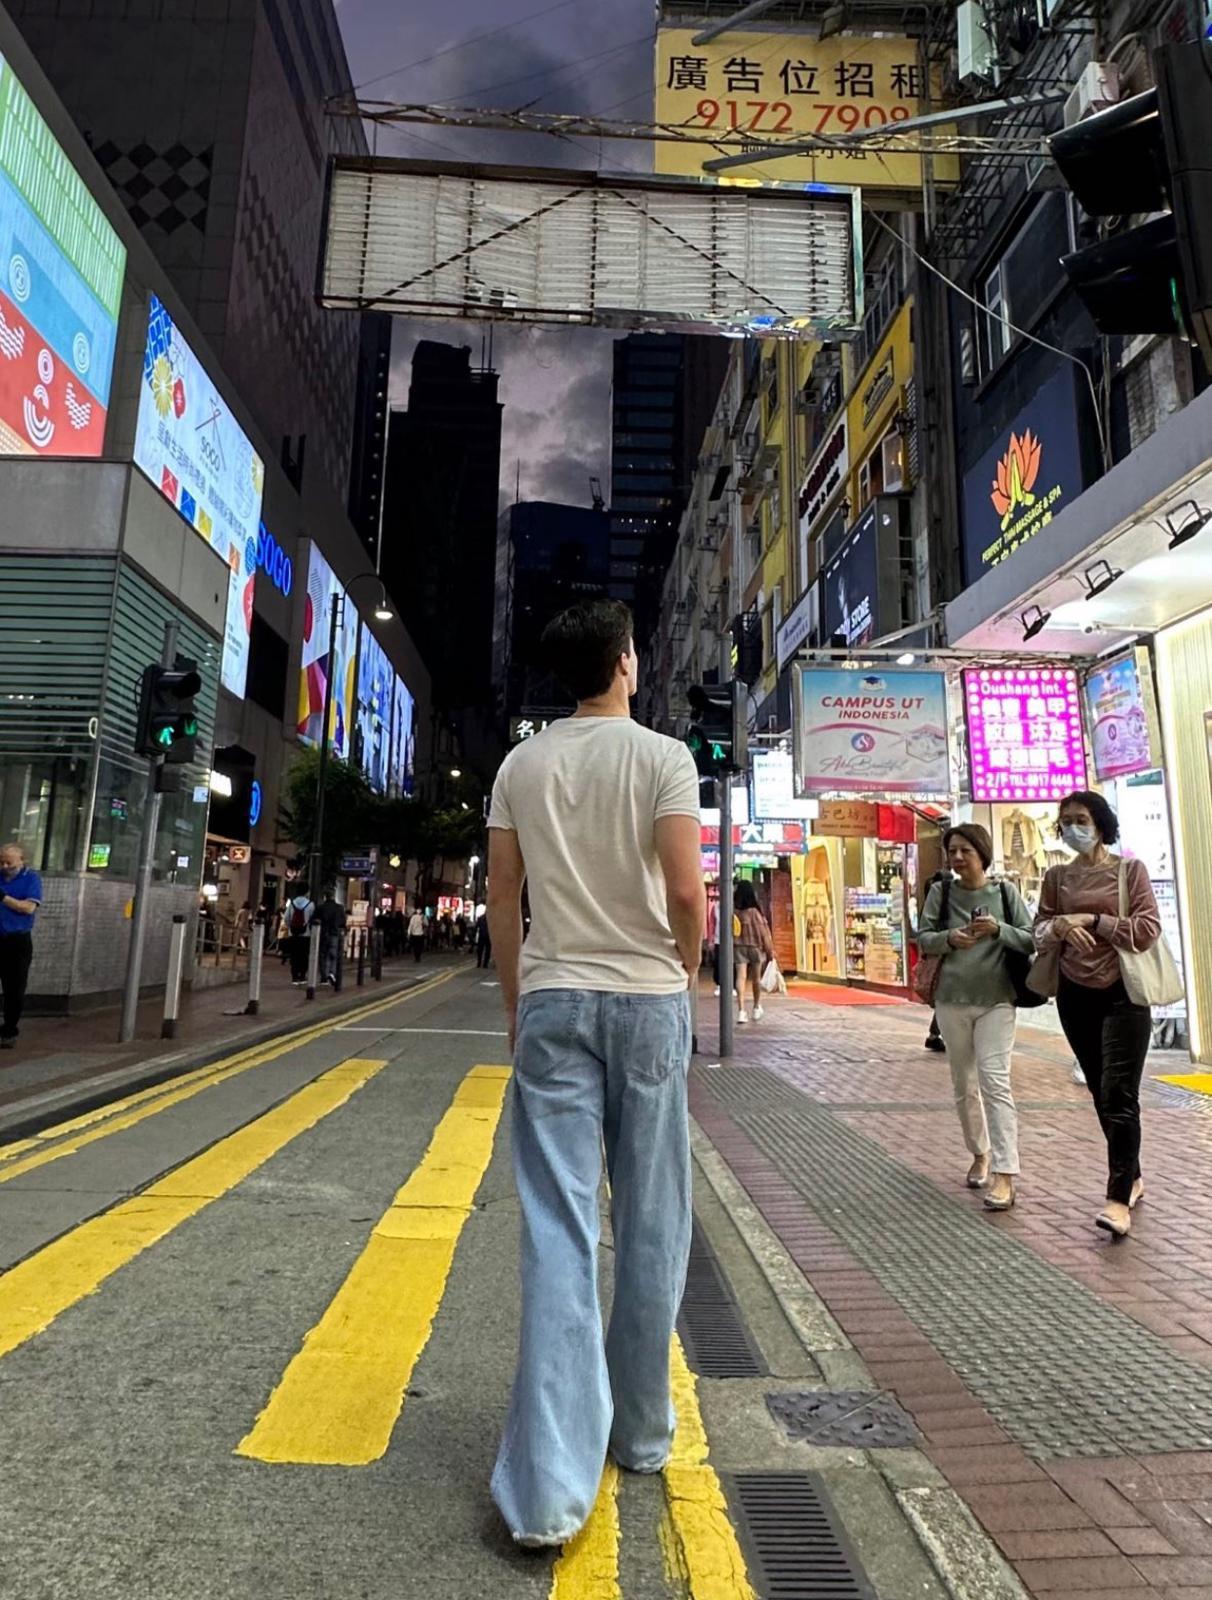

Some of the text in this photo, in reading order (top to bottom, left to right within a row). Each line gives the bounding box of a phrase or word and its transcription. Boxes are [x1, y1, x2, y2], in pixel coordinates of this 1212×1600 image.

[667, 55, 925, 98] 廣告位招租
[697, 99, 793, 134] 9172
[257, 520, 292, 597] SOGO
[821, 696, 925, 709] CAMPUS UT
[838, 710, 910, 720] INDONESIA
[516, 719, 548, 739] 名
